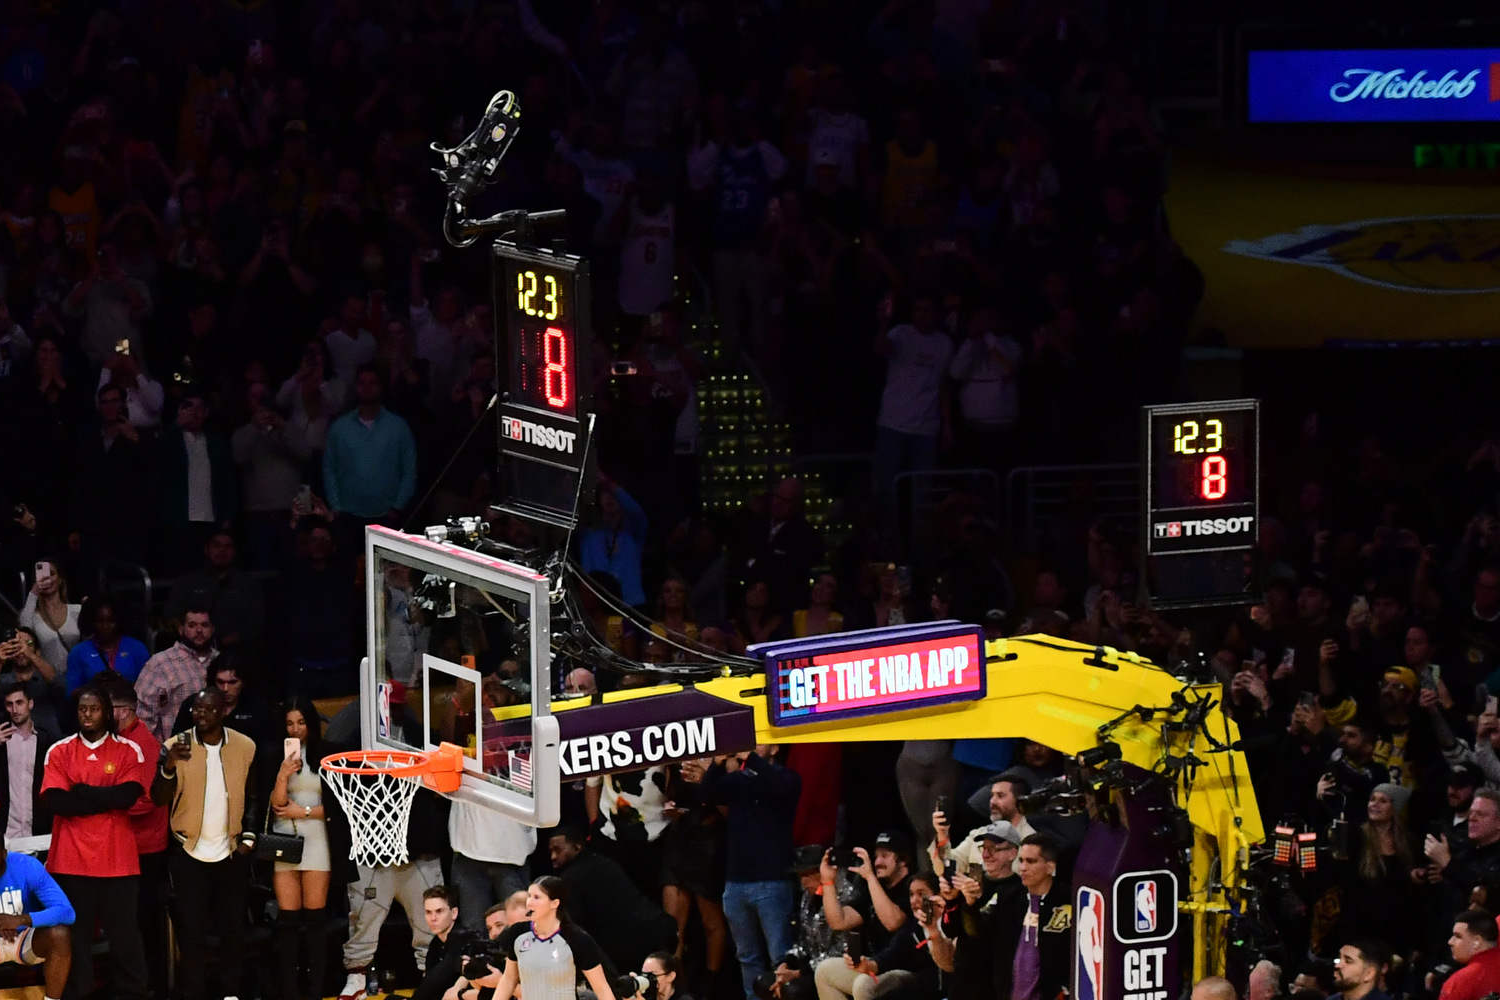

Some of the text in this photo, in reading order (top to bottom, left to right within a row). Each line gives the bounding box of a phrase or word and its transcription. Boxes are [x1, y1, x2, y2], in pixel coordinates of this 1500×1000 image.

[1329, 68, 1482, 103] Michelob
[518, 271, 558, 321] 12.3
[544, 327, 567, 408] 8
[522, 423, 577, 454] TISSOT
[1174, 419, 1222, 454] 12.3
[1202, 455, 1227, 500] 8
[1182, 516, 1254, 537] TISSOT
[789, 645, 969, 708] GET THE NBA APP
[1123, 946, 1168, 992] GET
